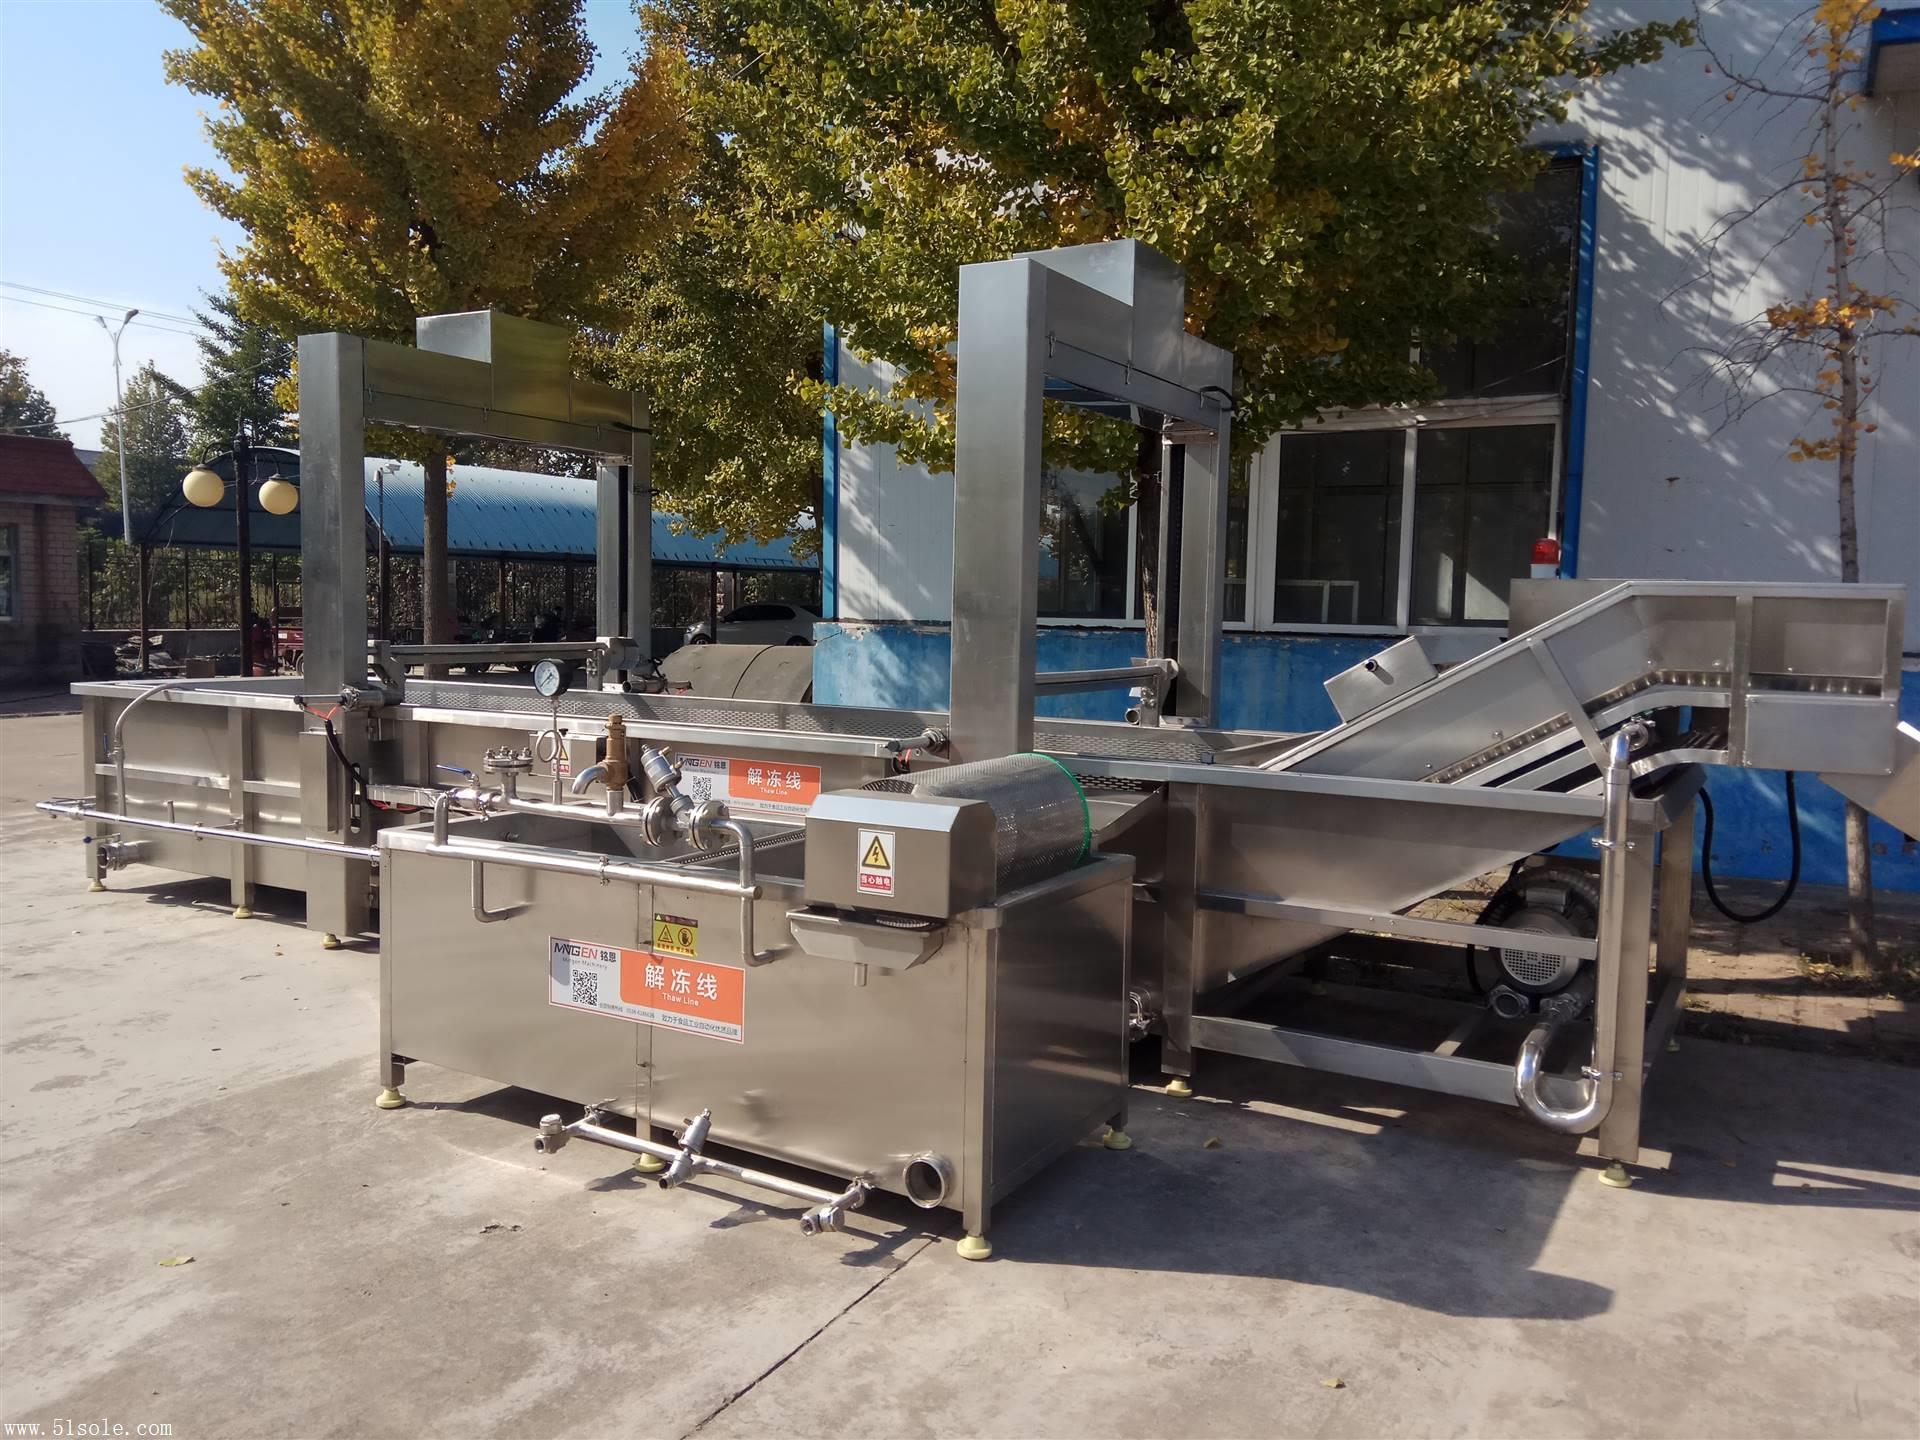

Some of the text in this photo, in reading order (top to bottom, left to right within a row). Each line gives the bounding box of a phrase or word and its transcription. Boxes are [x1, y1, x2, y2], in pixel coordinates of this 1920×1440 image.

[747, 767, 801, 790] 解冻线
[644, 962, 718, 1001] 解冻线
[662, 992, 699, 1006] Thaw Line
